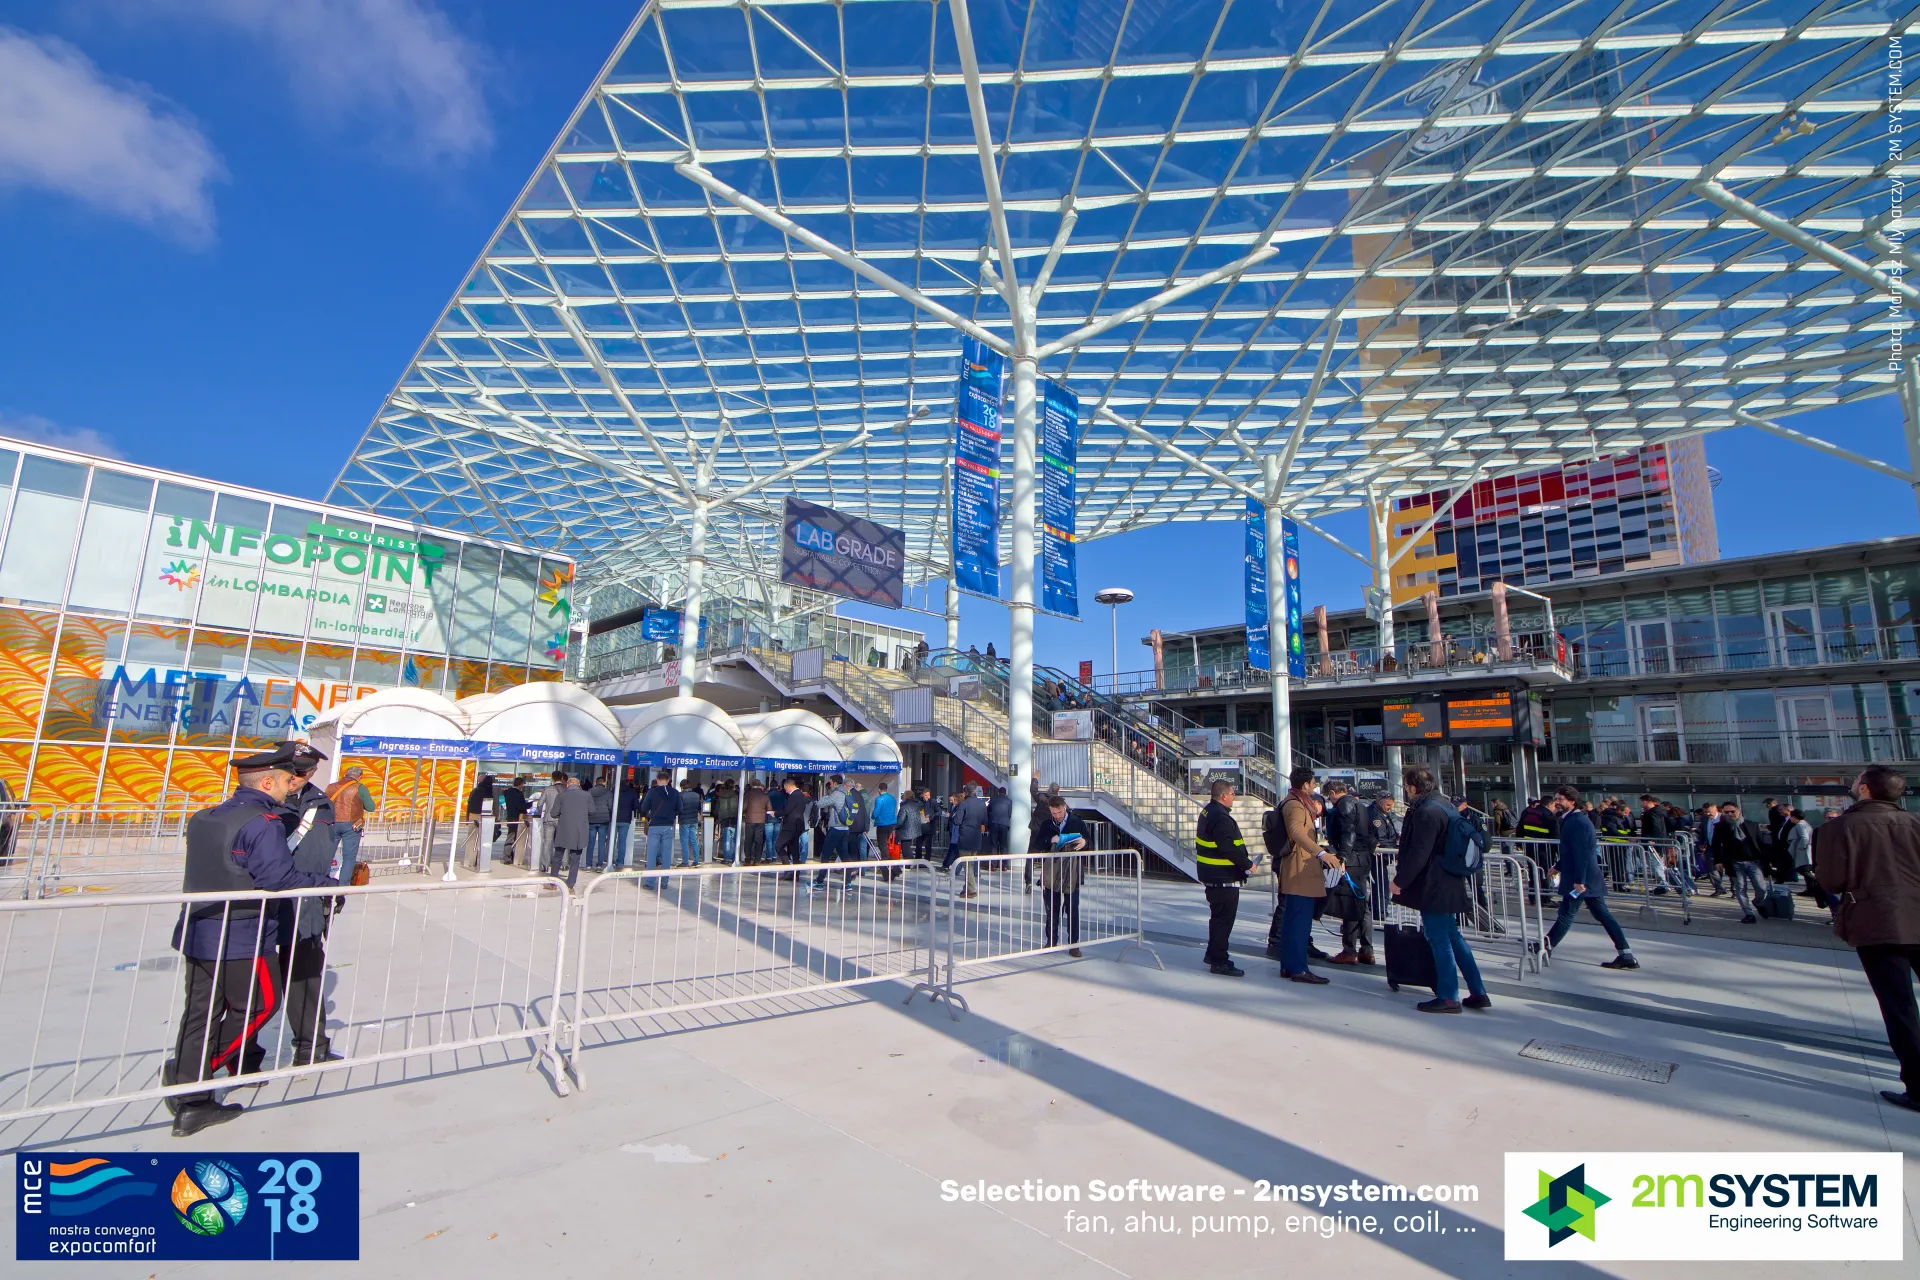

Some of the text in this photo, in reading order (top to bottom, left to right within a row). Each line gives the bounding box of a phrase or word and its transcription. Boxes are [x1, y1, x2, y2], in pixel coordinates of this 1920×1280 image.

[983, 404, 997, 418] 20
[983, 416, 996, 429] 18
[336, 528, 418, 551] TOURIST
[793, 548, 836, 564] SUSTAINABLE
[1475, 620, 1514, 634] Snak
[1520, 618, 1531, 628] &
[101, 701, 316, 733] ENERGIA E GAS
[378, 741, 420, 752] Ingresso
[430, 743, 470, 754] Entrance
[522, 748, 565, 759] Ingresso
[574, 752, 616, 762] Entrance
[664, 755, 698, 766] Ingresso
[705, 756, 739, 767] Entrance
[774, 760, 802, 770] Ingresso
[808, 762, 837, 771] Entrance
[857, 764, 876, 772] Ingresso
[1010, 764, 1016, 772] 4
